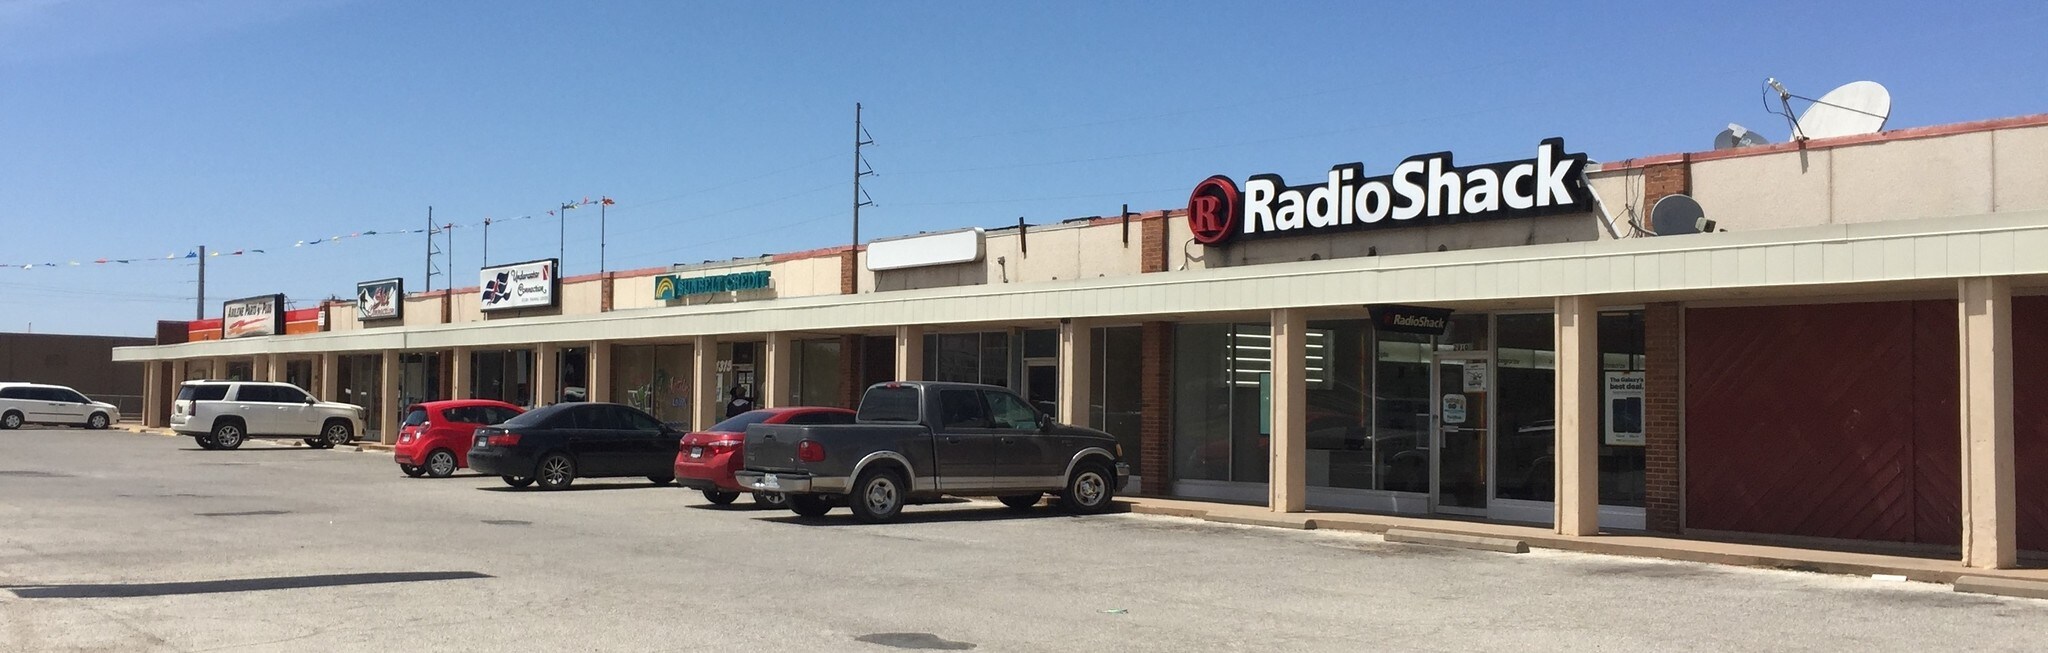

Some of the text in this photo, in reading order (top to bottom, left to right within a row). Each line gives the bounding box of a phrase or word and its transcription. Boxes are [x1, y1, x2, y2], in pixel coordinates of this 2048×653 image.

[1243, 143, 1574, 234] RadioShack
[677, 271, 771, 296] SUNBELT CREDIT
[1393, 314, 1445, 329] RadioShack
[1610, 382, 1626, 390] best
